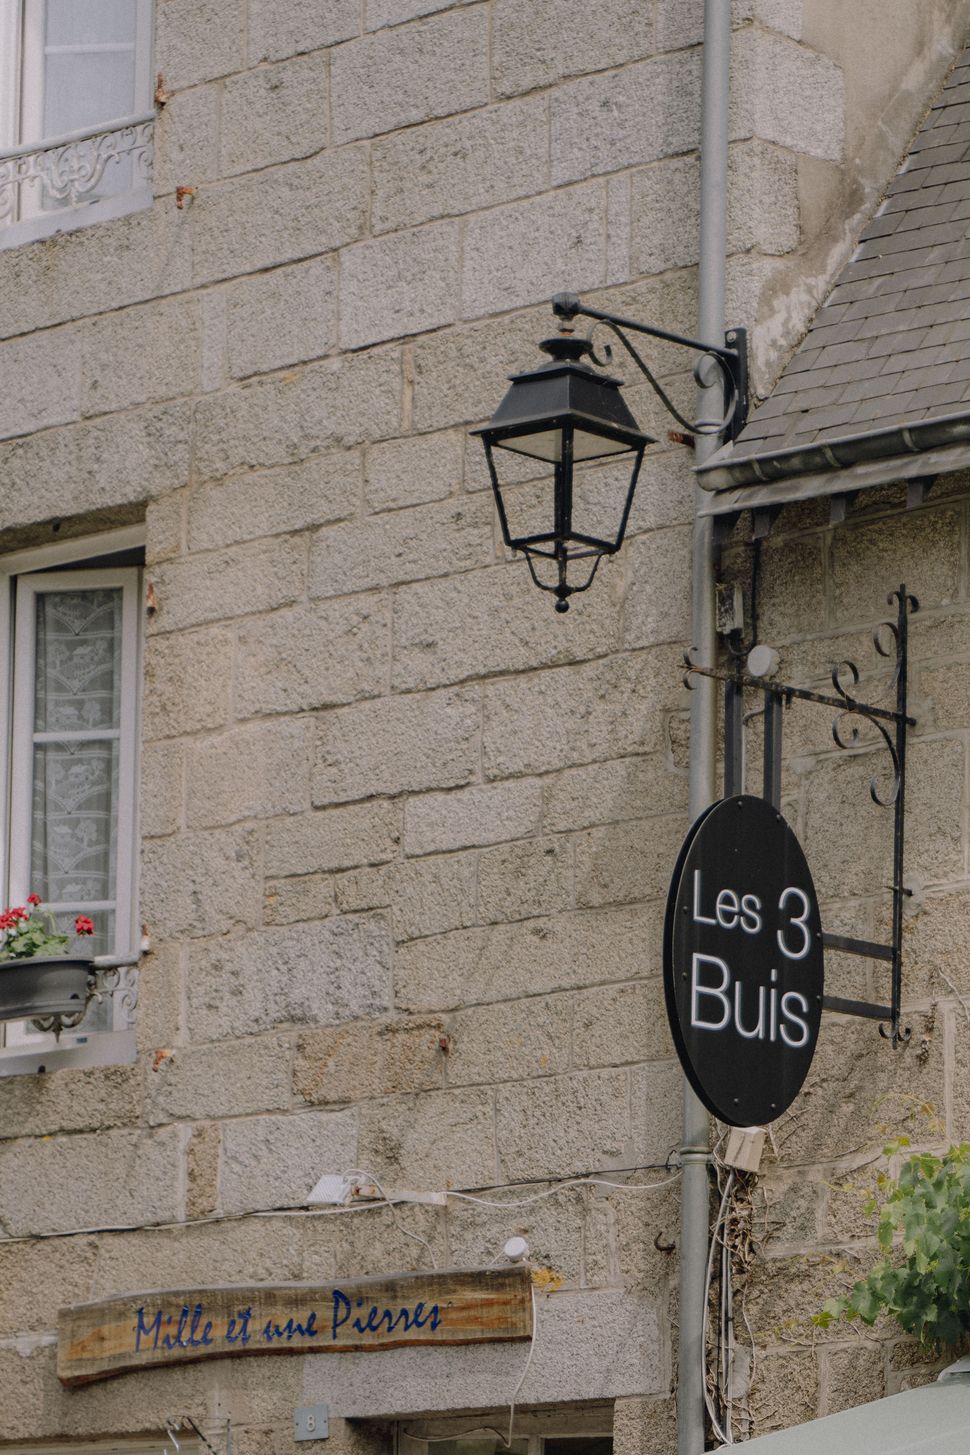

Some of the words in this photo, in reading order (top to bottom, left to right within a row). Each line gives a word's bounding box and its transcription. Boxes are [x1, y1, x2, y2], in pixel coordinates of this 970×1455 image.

[692, 868, 763, 935] Les
[776, 886, 812, 960] 3
[690, 951, 810, 1048] Buis
[135, 1303, 215, 1353] Mille
[225, 1306, 252, 1346] et
[263, 1311, 318, 1342] une
[331, 1288, 442, 1341] Pierres
[307, 1414, 315, 1431] 8
